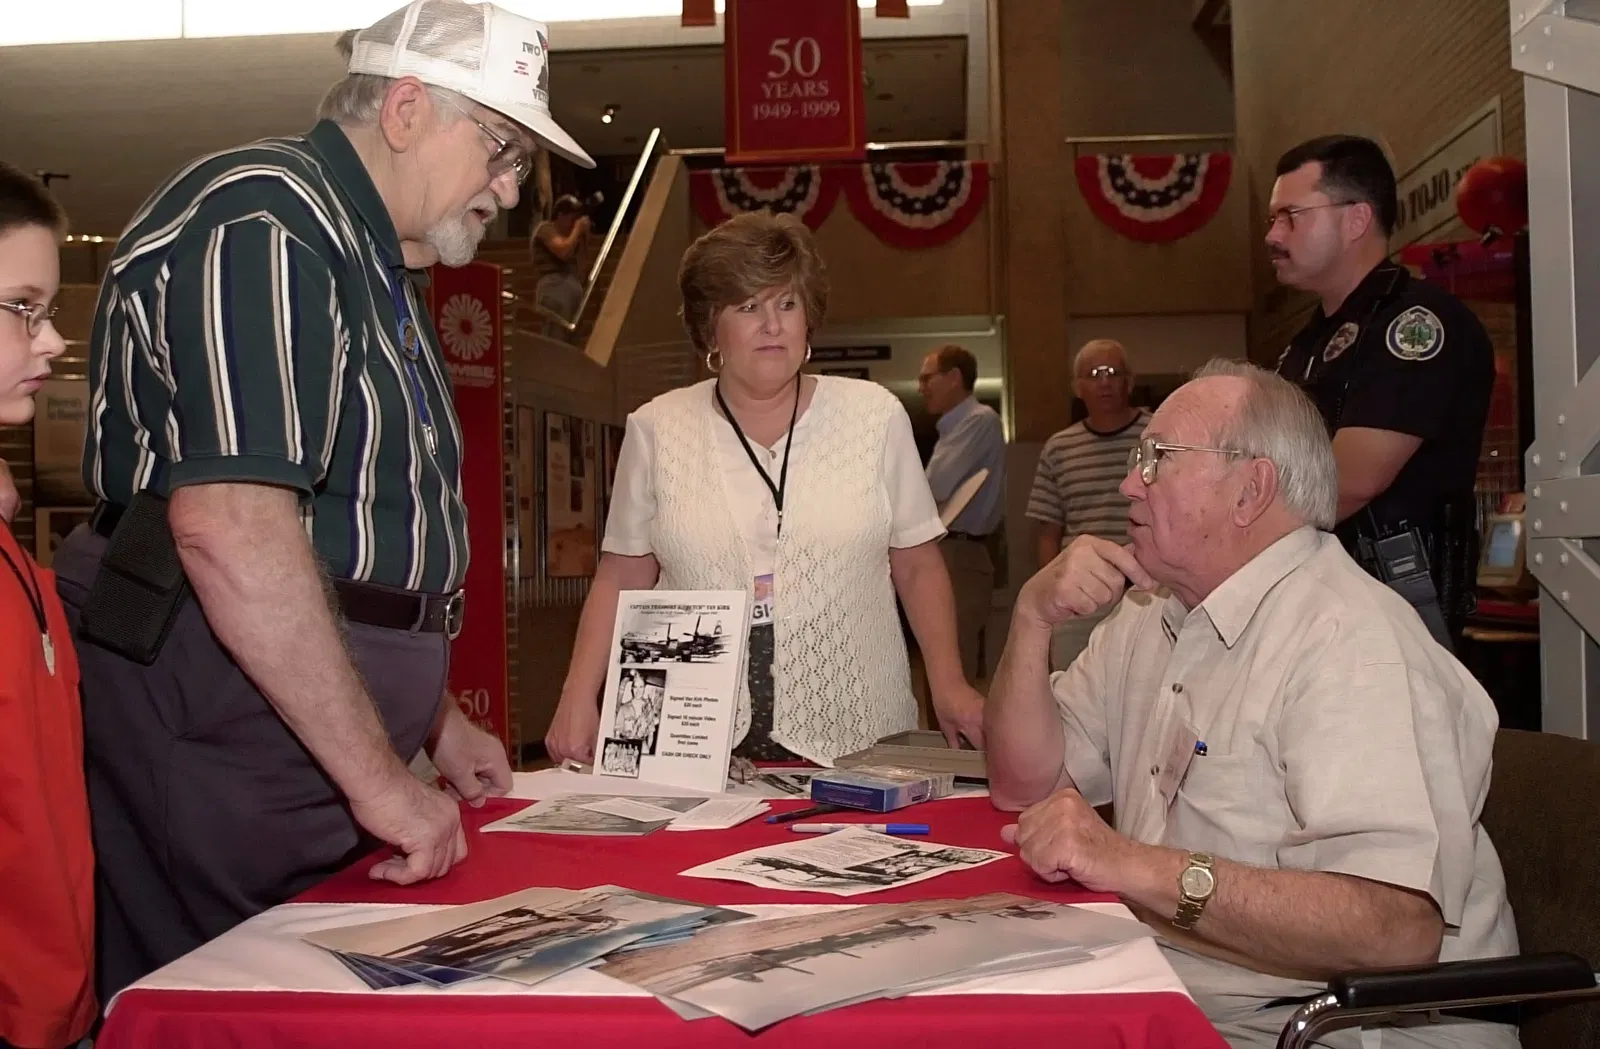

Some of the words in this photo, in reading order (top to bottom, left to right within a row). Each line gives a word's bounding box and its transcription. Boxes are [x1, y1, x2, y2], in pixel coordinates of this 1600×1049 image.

[767, 36, 821, 79] 50
[760, 80, 829, 99] YEARS
[1408, 168, 1450, 222] TOJO
[460, 688, 490, 717] 50
